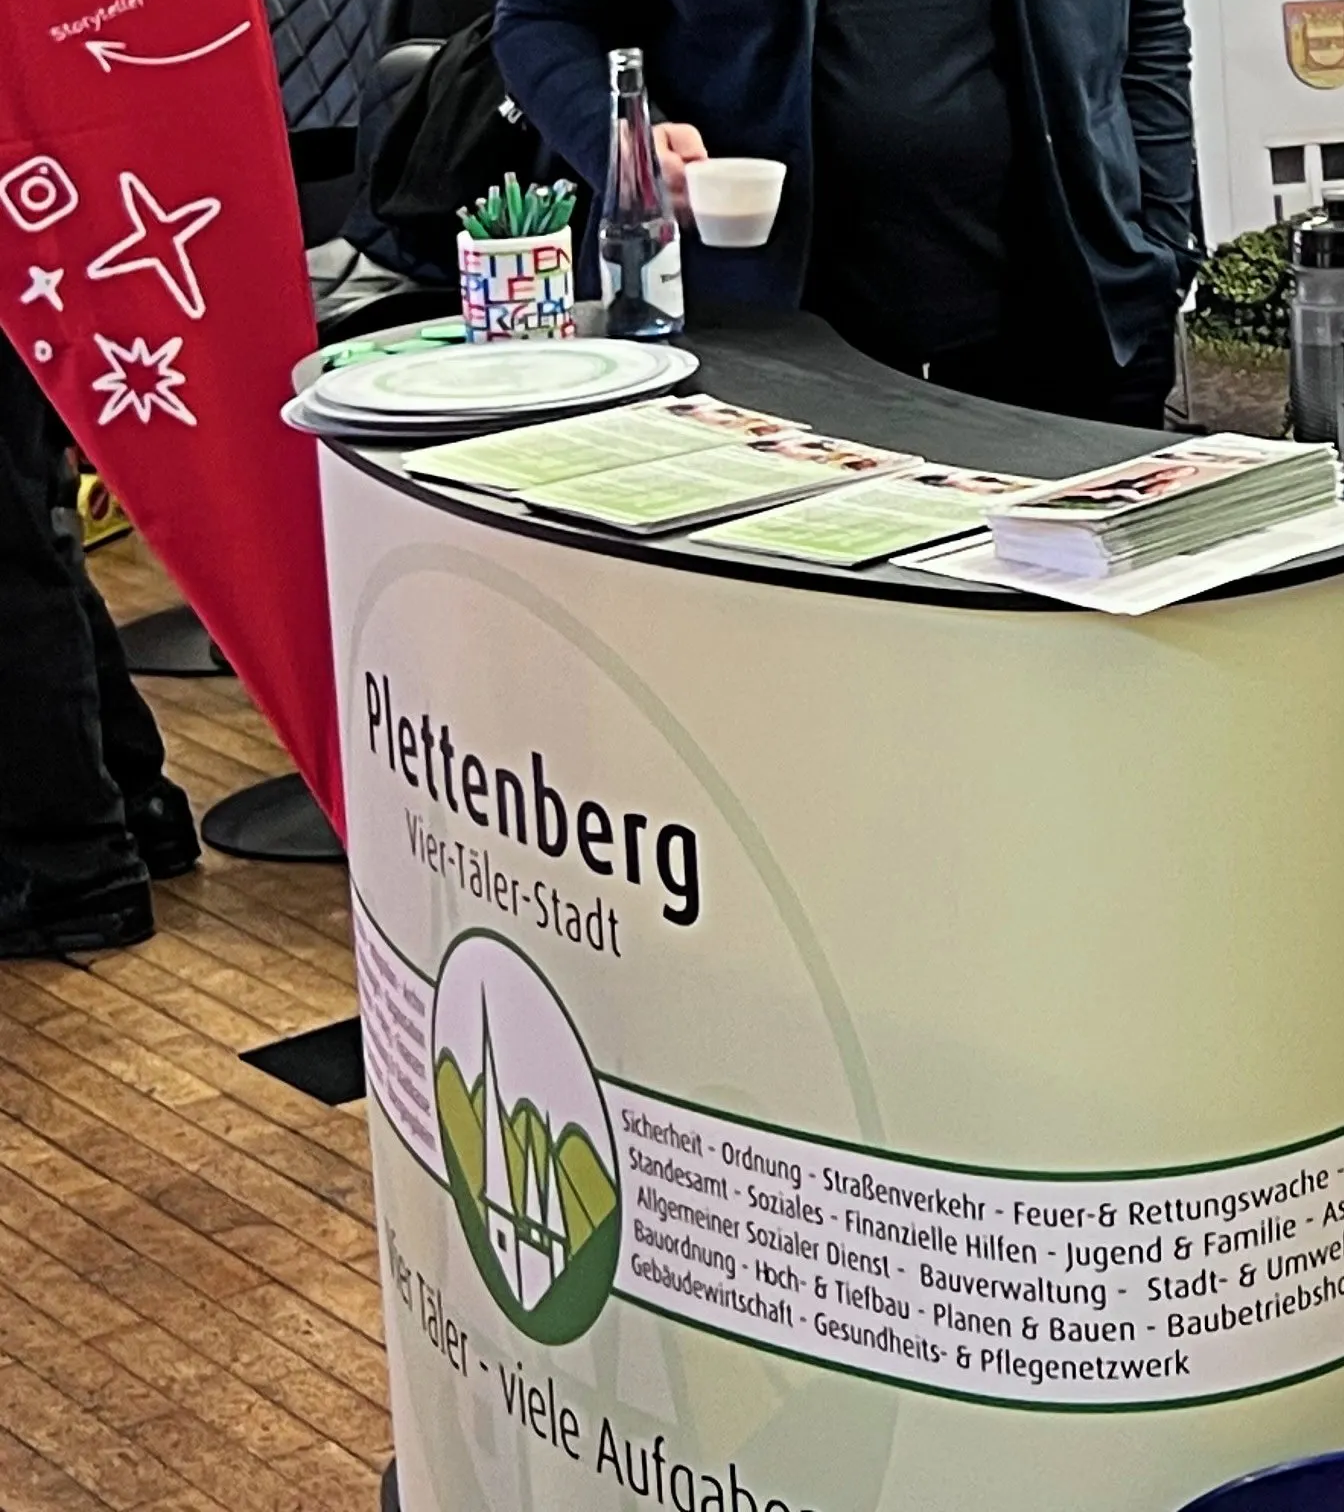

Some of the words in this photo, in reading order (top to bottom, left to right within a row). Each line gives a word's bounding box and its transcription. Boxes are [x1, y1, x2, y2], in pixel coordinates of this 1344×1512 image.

[364, 671, 701, 927] Plettenberg
[403, 807, 623, 958] Vier-Täler-Stadt
[621, 1108, 703, 1158] Sicherheit
[721, 1142, 802, 1190] Ordnung
[822, 1167, 986, 1223] Straßenverkehr
[1128, 1165, 1330, 1227] Rettungswache
[627, 1146, 729, 1202] Standesamt
[747, 1184, 825, 1226] Soziales
[845, 1210, 959, 1257] Finanzielle
[965, 1233, 1037, 1266] Hilfen
[1065, 1236, 1163, 1274] Jugend
[1173, 1237, 1193, 1261] &
[1203, 1214, 1297, 1258] Familie
[633, 1217, 737, 1280] Bauordnung
[755, 1257, 807, 1295] Hoch-
[814, 1275, 827, 1301] &
[835, 1278, 910, 1322] Tiefbau
[933, 1303, 1013, 1340] Planen
[1022, 1315, 1040, 1341] &
[1049, 1317, 1136, 1344] Bauen
[636, 1184, 741, 1242] Allgemeiner
[747, 1220, 820, 1263] Sozialer
[826, 1242, 890, 1280] Dienst
[919, 1262, 1107, 1310] Bauverwaltung
[1147, 1272, 1229, 1303] Stadt-
[1239, 1264, 1258, 1288] &
[630, 1252, 794, 1330] Gebäudewirtschaft
[813, 1312, 948, 1366] Gesundheits-
[956, 1345, 973, 1371] &
[980, 1348, 1191, 1386] Pflegenetzwerk
[416, 1270, 468, 1379] Täler
[499, 1360, 580, 1461] viele
[597, 1416, 814, 1512] Aufgab
